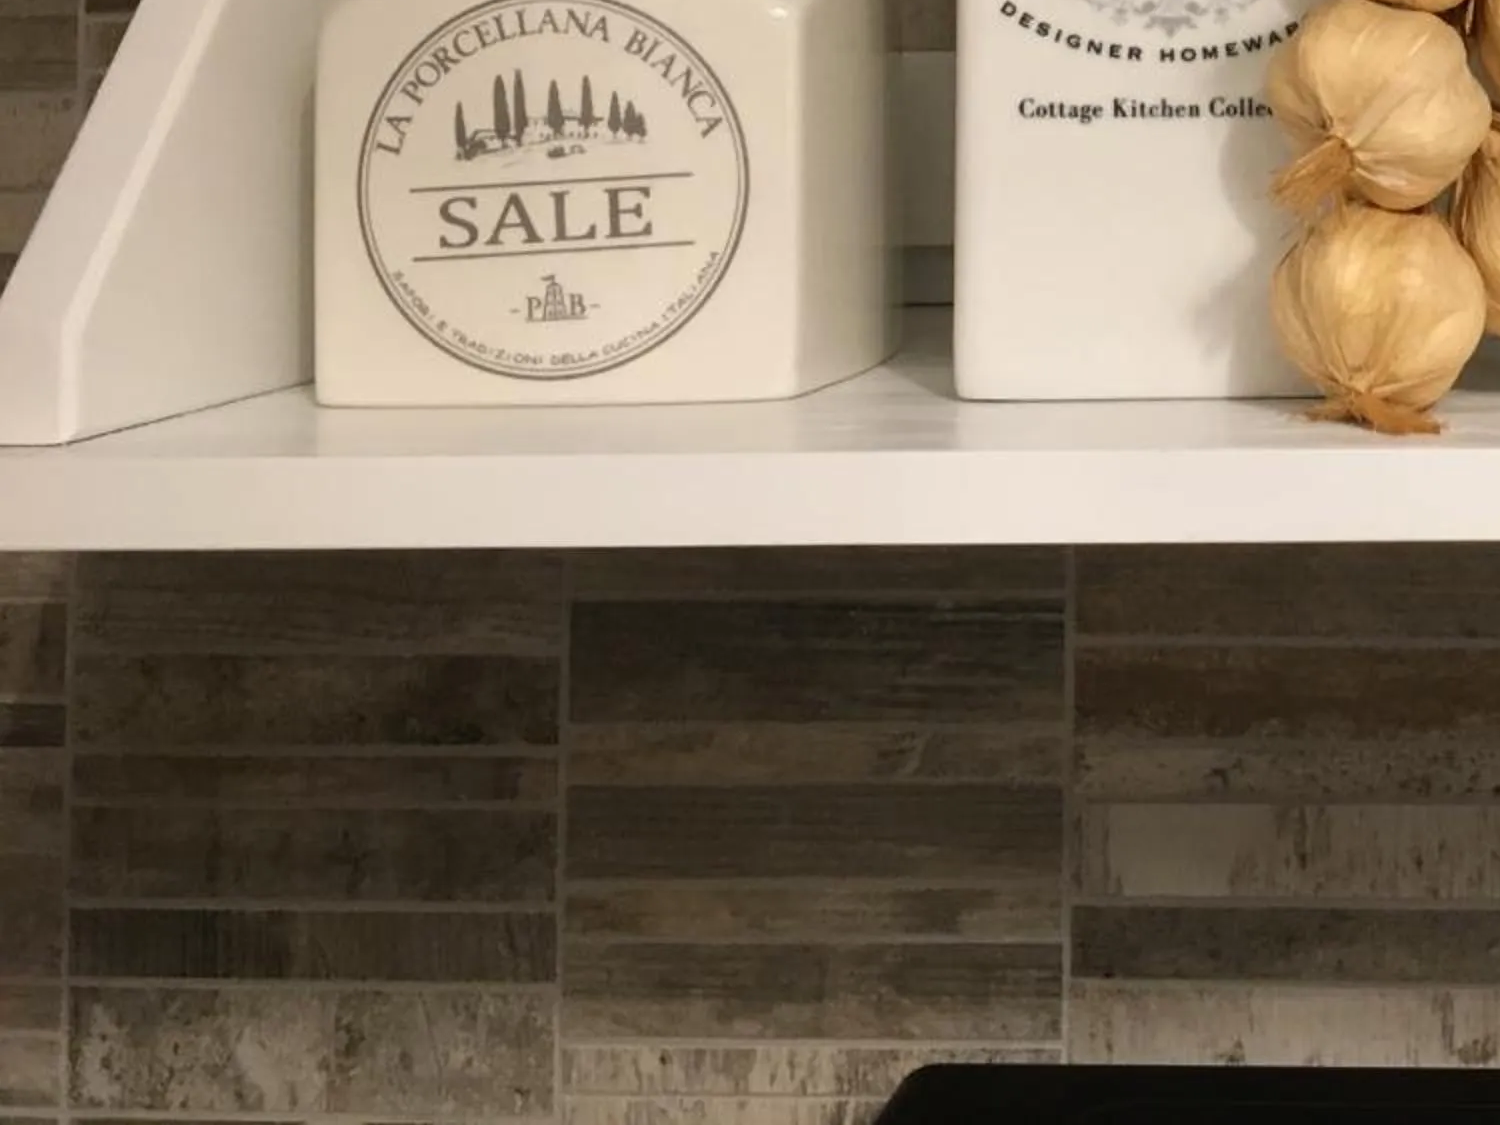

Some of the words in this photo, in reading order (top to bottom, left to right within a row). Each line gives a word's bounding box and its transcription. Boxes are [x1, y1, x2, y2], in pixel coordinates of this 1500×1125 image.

[1000, 0, 1142, 61] DESIGNER
[375, 111, 412, 156] LA
[400, 8, 612, 105] PORCELLANA
[624, 27, 723, 139] BIANCA
[1018, 97, 1104, 123] Cottage
[1112, 97, 1200, 119] Kitchen
[438, 187, 652, 249] SALE
